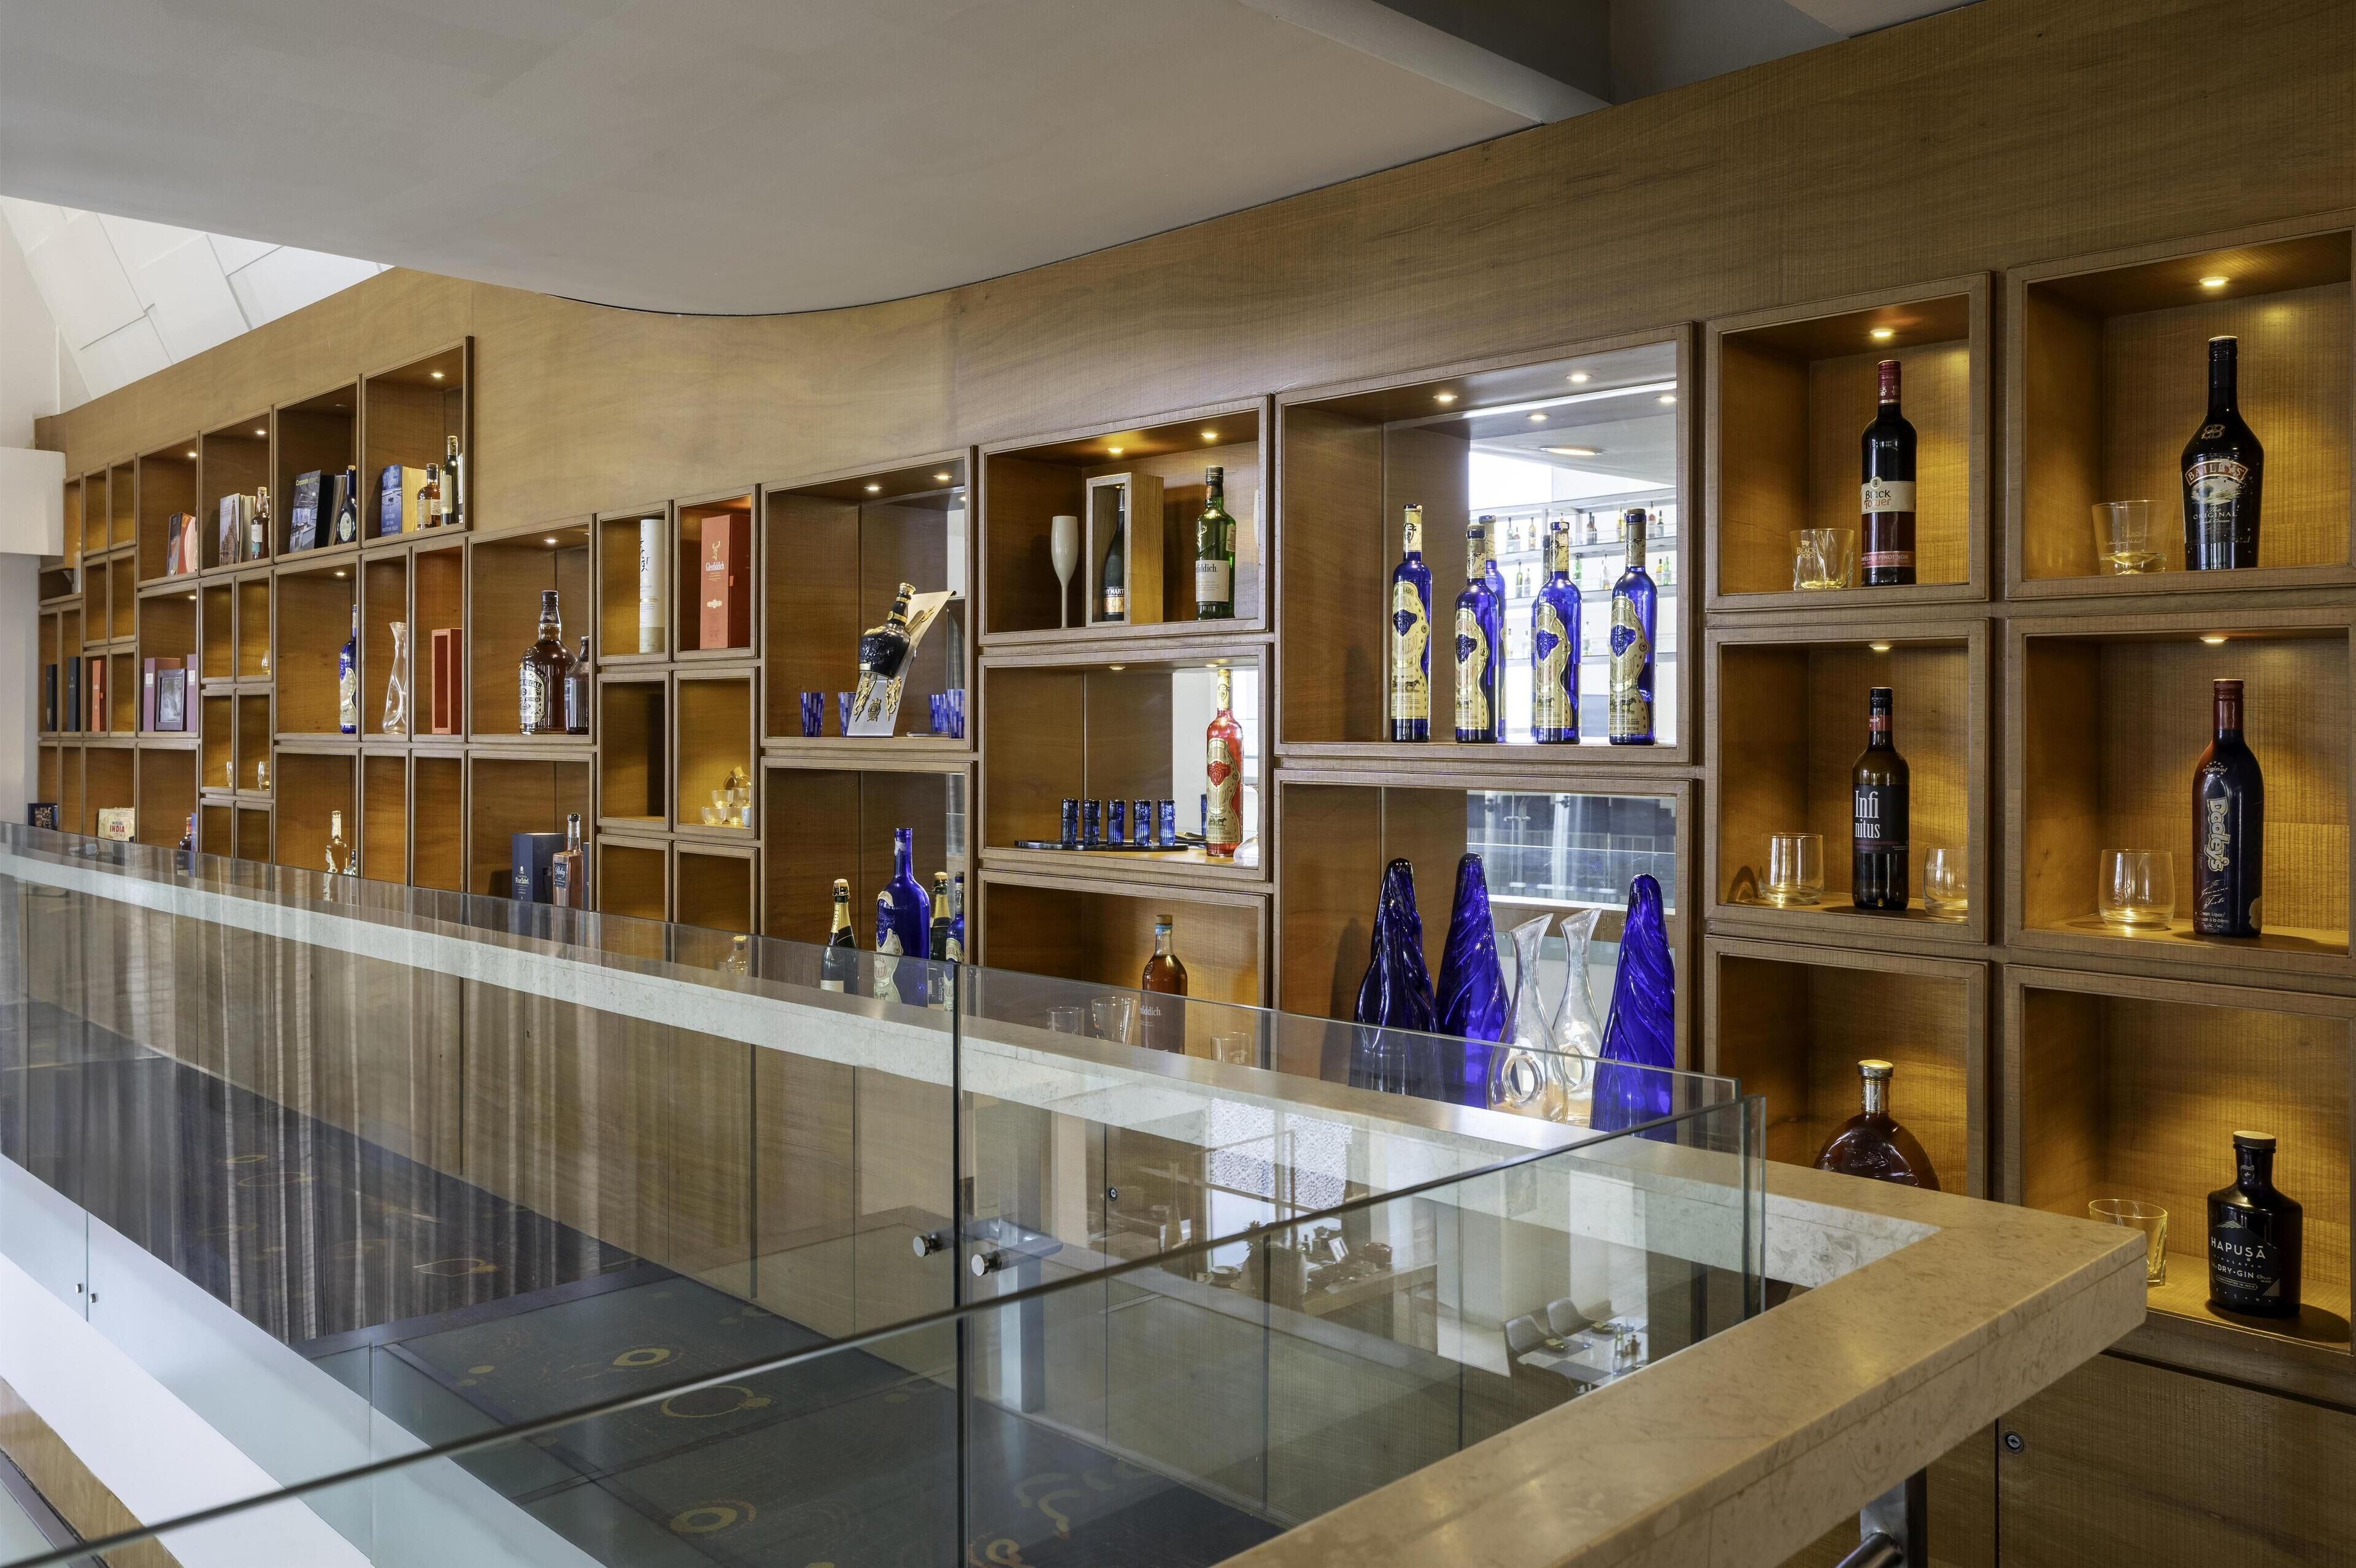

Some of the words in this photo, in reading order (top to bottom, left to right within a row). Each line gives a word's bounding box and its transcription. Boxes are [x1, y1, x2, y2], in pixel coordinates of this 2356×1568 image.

[1865, 490, 1891, 499] Black
[1864, 498, 1892, 509] Tower
[527, 680, 541, 688] REGAL
[1855, 790, 1879, 818] Infi
[1855, 818, 1881, 839] nitus
[2204, 796, 2231, 872] Dooley's
